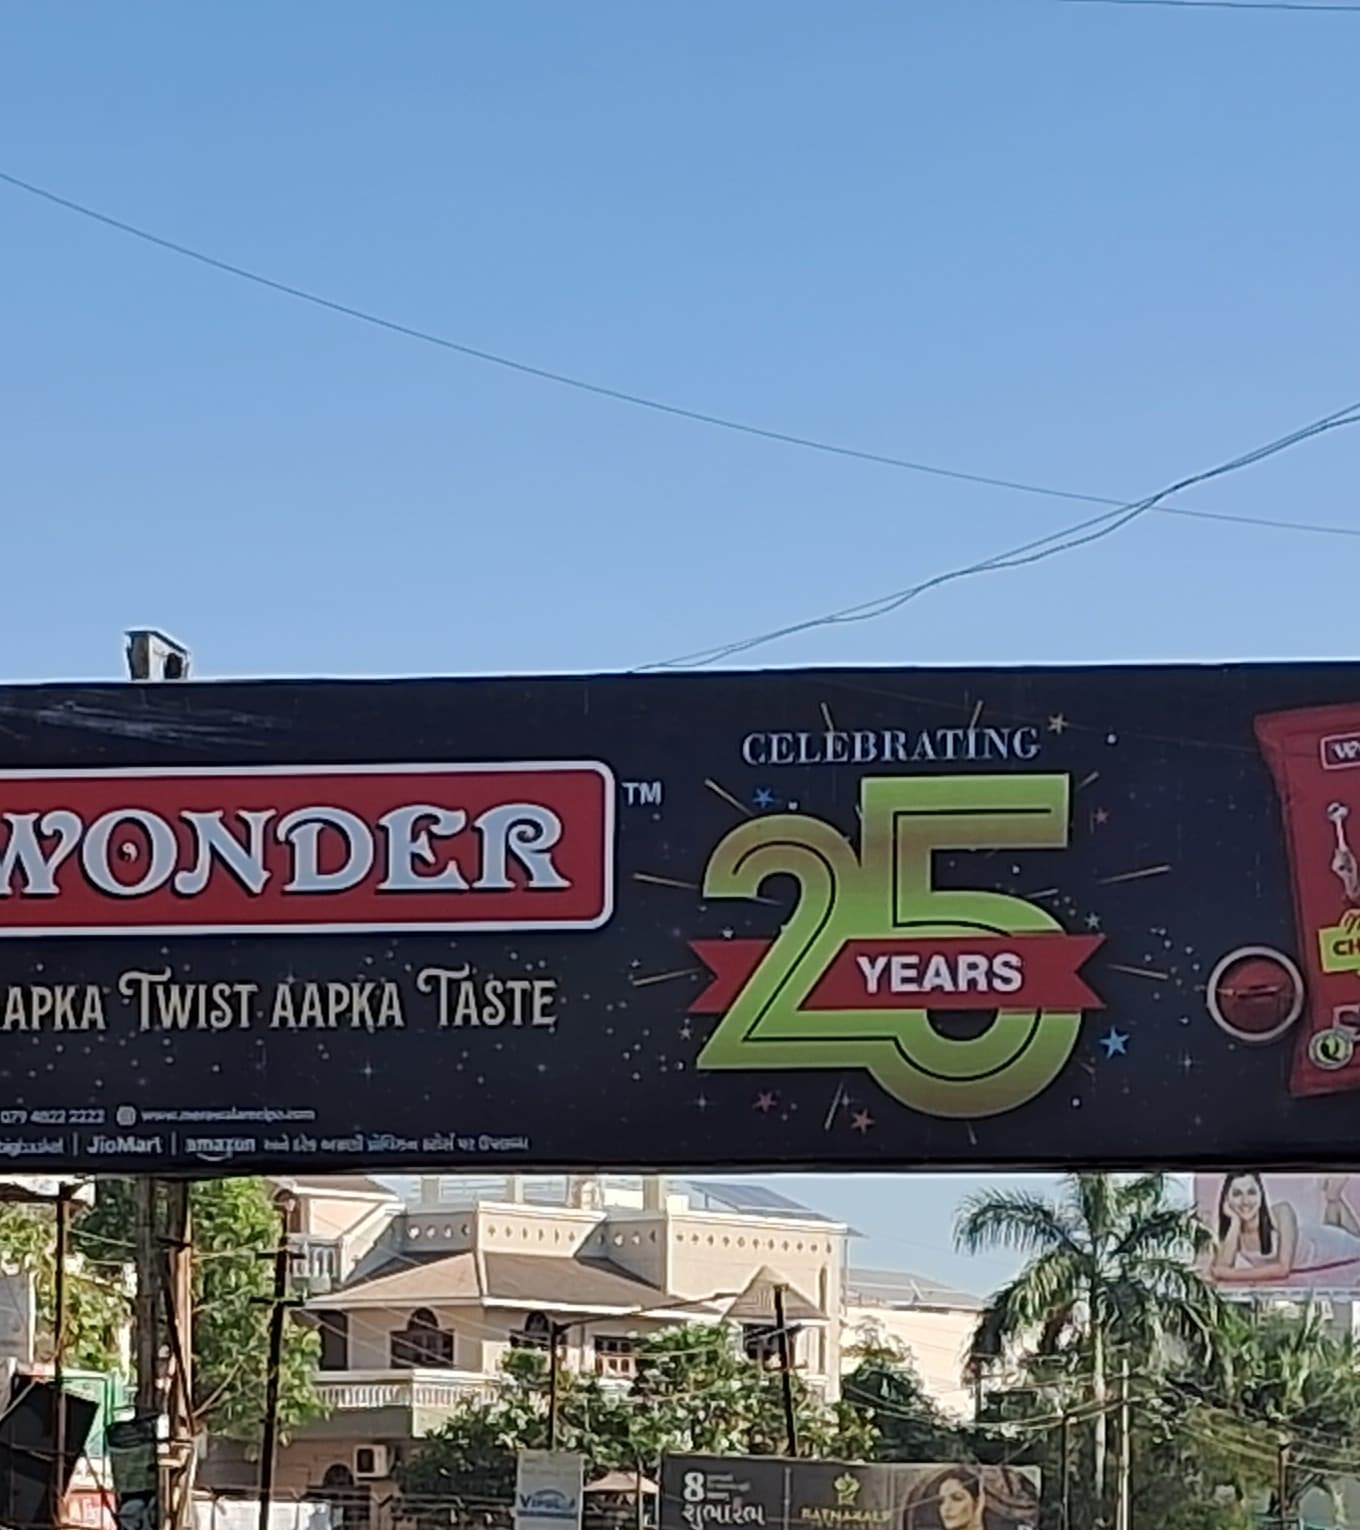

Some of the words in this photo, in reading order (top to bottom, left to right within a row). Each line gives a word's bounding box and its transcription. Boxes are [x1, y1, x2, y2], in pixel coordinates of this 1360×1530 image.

[742, 727, 1040, 764] CELEBRATING
[623, 782, 661, 804] TM
[697, 773, 1083, 1119] 25
[857, 953, 1023, 994] YEARS
[271, 982, 405, 1031] AAPKA
[87, 1135, 163, 1153] JioMart
[186, 1138, 255, 1153] amazon
[683, 1472, 705, 1502] 8
